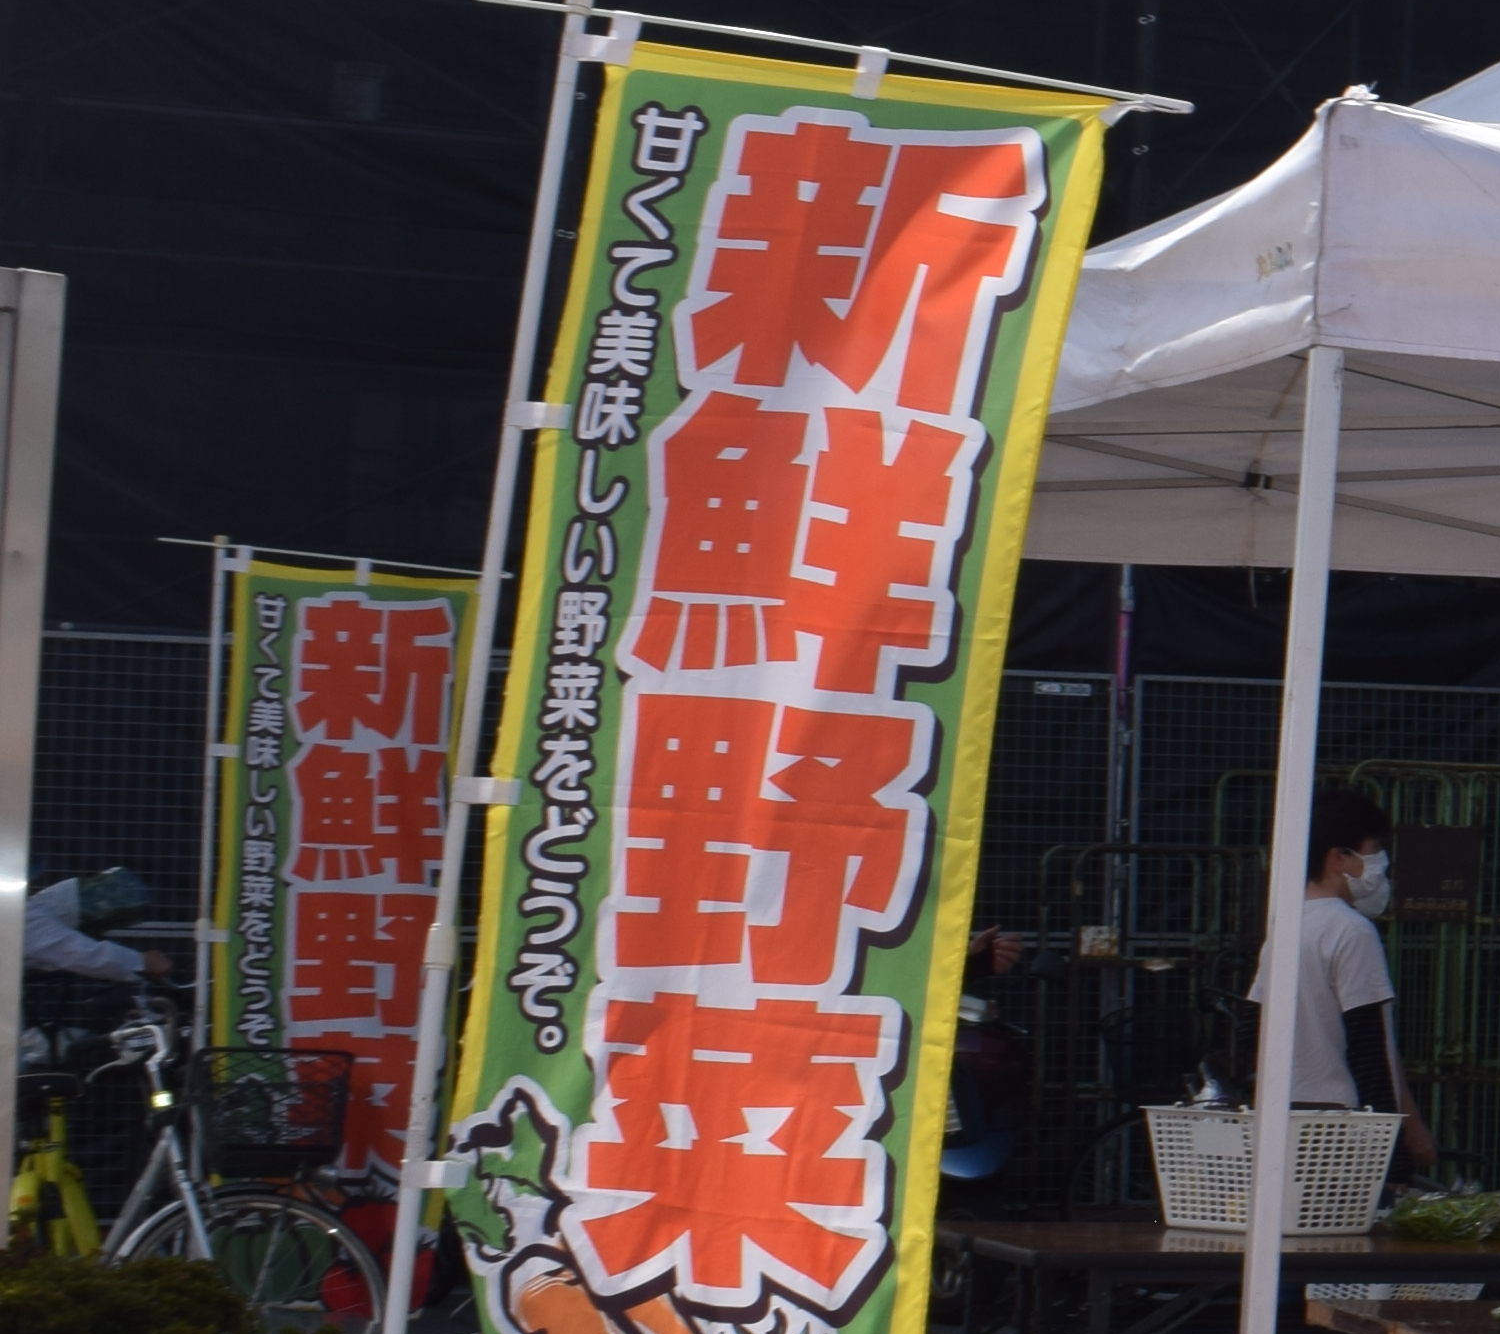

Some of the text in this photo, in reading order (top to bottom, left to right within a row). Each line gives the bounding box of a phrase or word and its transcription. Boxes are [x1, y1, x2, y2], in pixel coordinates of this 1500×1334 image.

[512, 105, 705, 1054] 甘くて美味しい野菜をどうぞ。
[575, 112, 1040, 1307] 新鮮野菜
